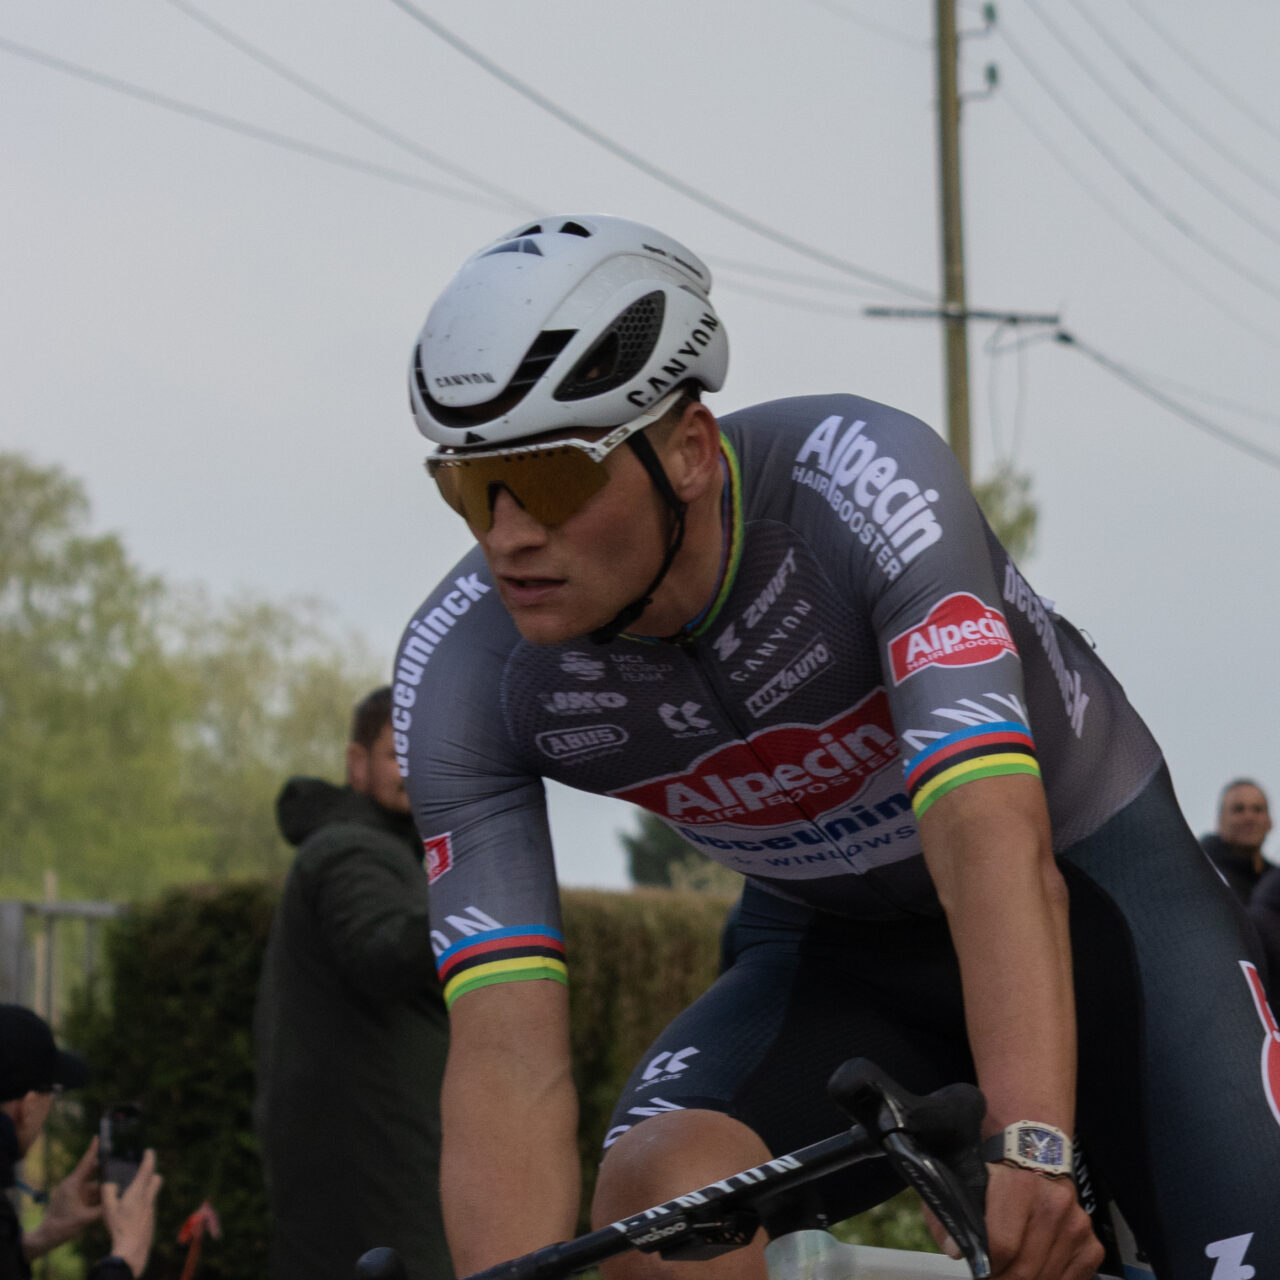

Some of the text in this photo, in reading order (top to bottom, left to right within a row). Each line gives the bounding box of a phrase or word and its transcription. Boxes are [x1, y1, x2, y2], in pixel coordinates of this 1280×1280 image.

[434, 371, 496, 388] CANYON
[627, 312, 720, 408] CANYON
[792, 465, 902, 581] HAIR BOOSTER
[795, 415, 943, 564] Alpecin
[729, 599, 812, 682] CANYON
[906, 612, 1010, 664] Alpecin
[548, 729, 617, 755] ABUS
[665, 723, 897, 815] Alpecin
[674, 804, 745, 823] HAIR
[633, 1221, 688, 1247] wahoo
